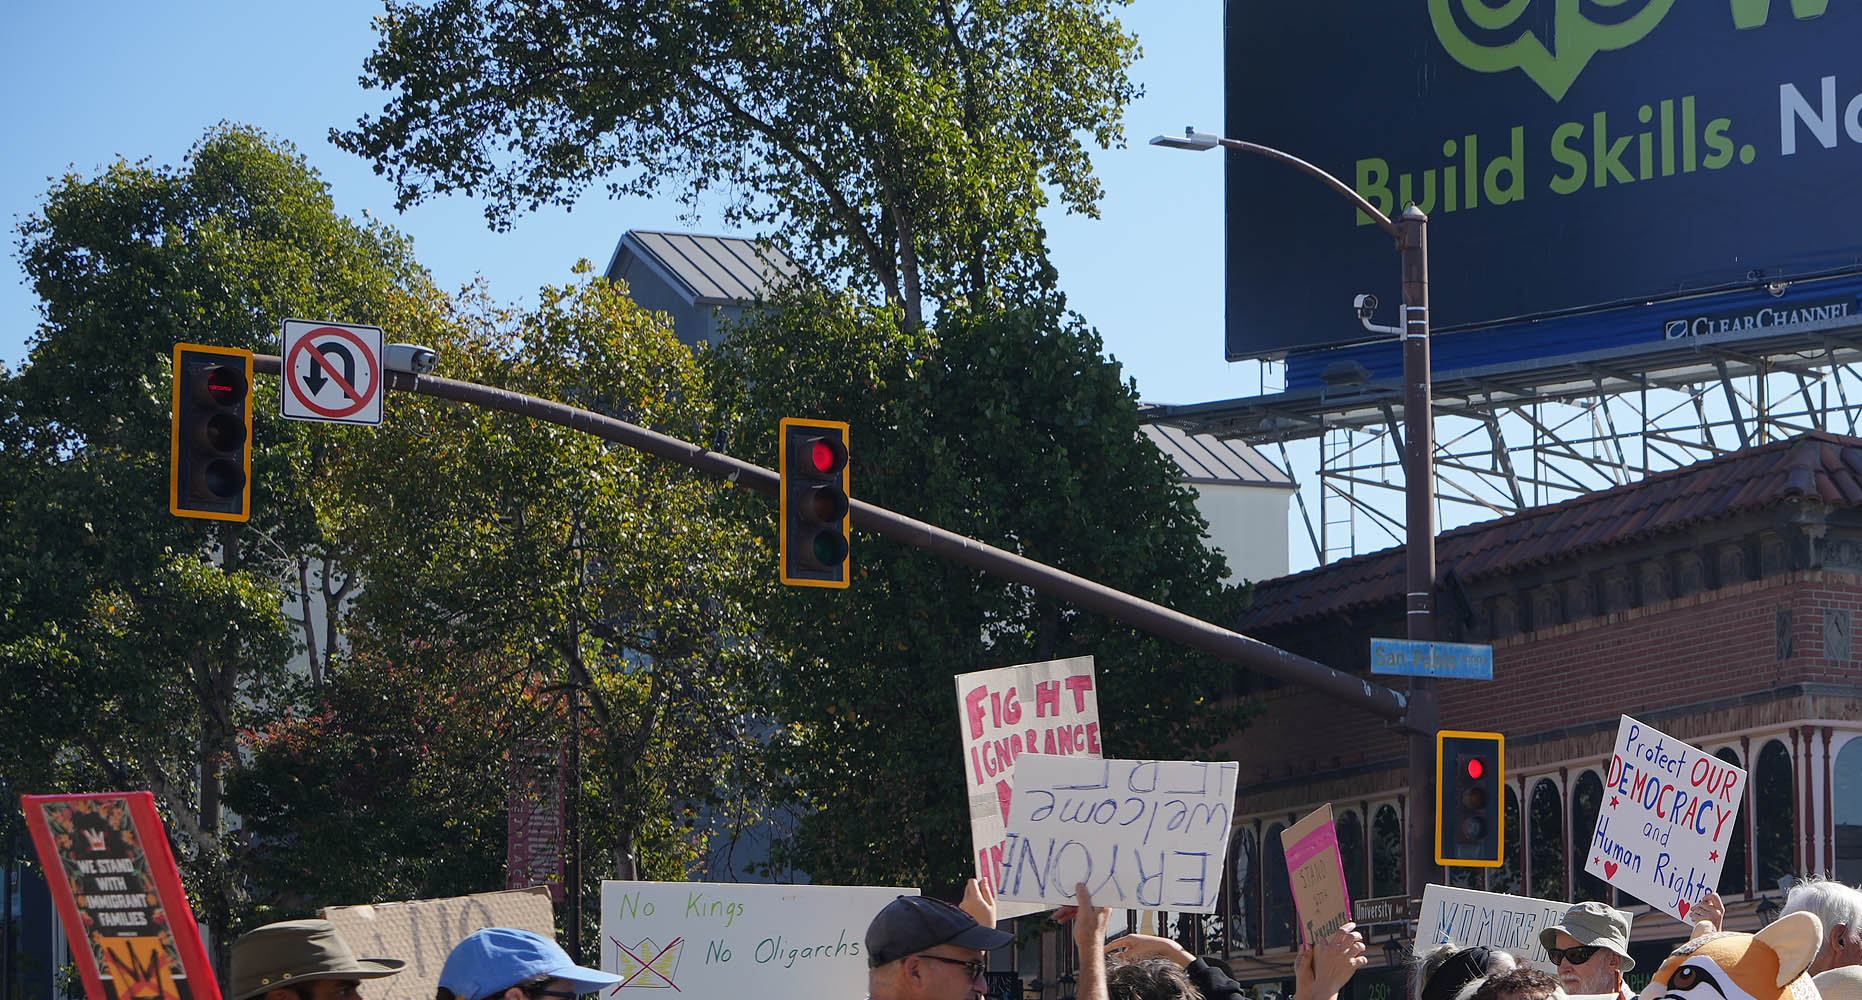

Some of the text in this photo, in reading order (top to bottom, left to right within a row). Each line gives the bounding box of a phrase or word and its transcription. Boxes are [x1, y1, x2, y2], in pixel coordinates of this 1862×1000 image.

[1356, 126, 1524, 227] Build
[1549, 95, 1756, 195] Skills.
[1374, 647, 1406, 667] San
[1413, 649, 1457, 670] Pablo
[965, 675, 1093, 740] FIGHT
[971, 722, 1100, 785] IGNORANCE
[1626, 725, 1737, 803] Protect OUR
[1607, 754, 1731, 842] DEMOCRACY
[1643, 822, 1672, 847] and
[76, 858, 133, 873] WE STAND
[1593, 815, 1712, 908] Human Rights
[86, 894, 148, 908] IMMIGRANT
[96, 877, 127, 890] WITH
[98, 912, 148, 926] FAMILIES
[620, 891, 744, 927] No Kings
[1357, 901, 1393, 921] University
[706, 928, 860, 968] No Oligarchs
